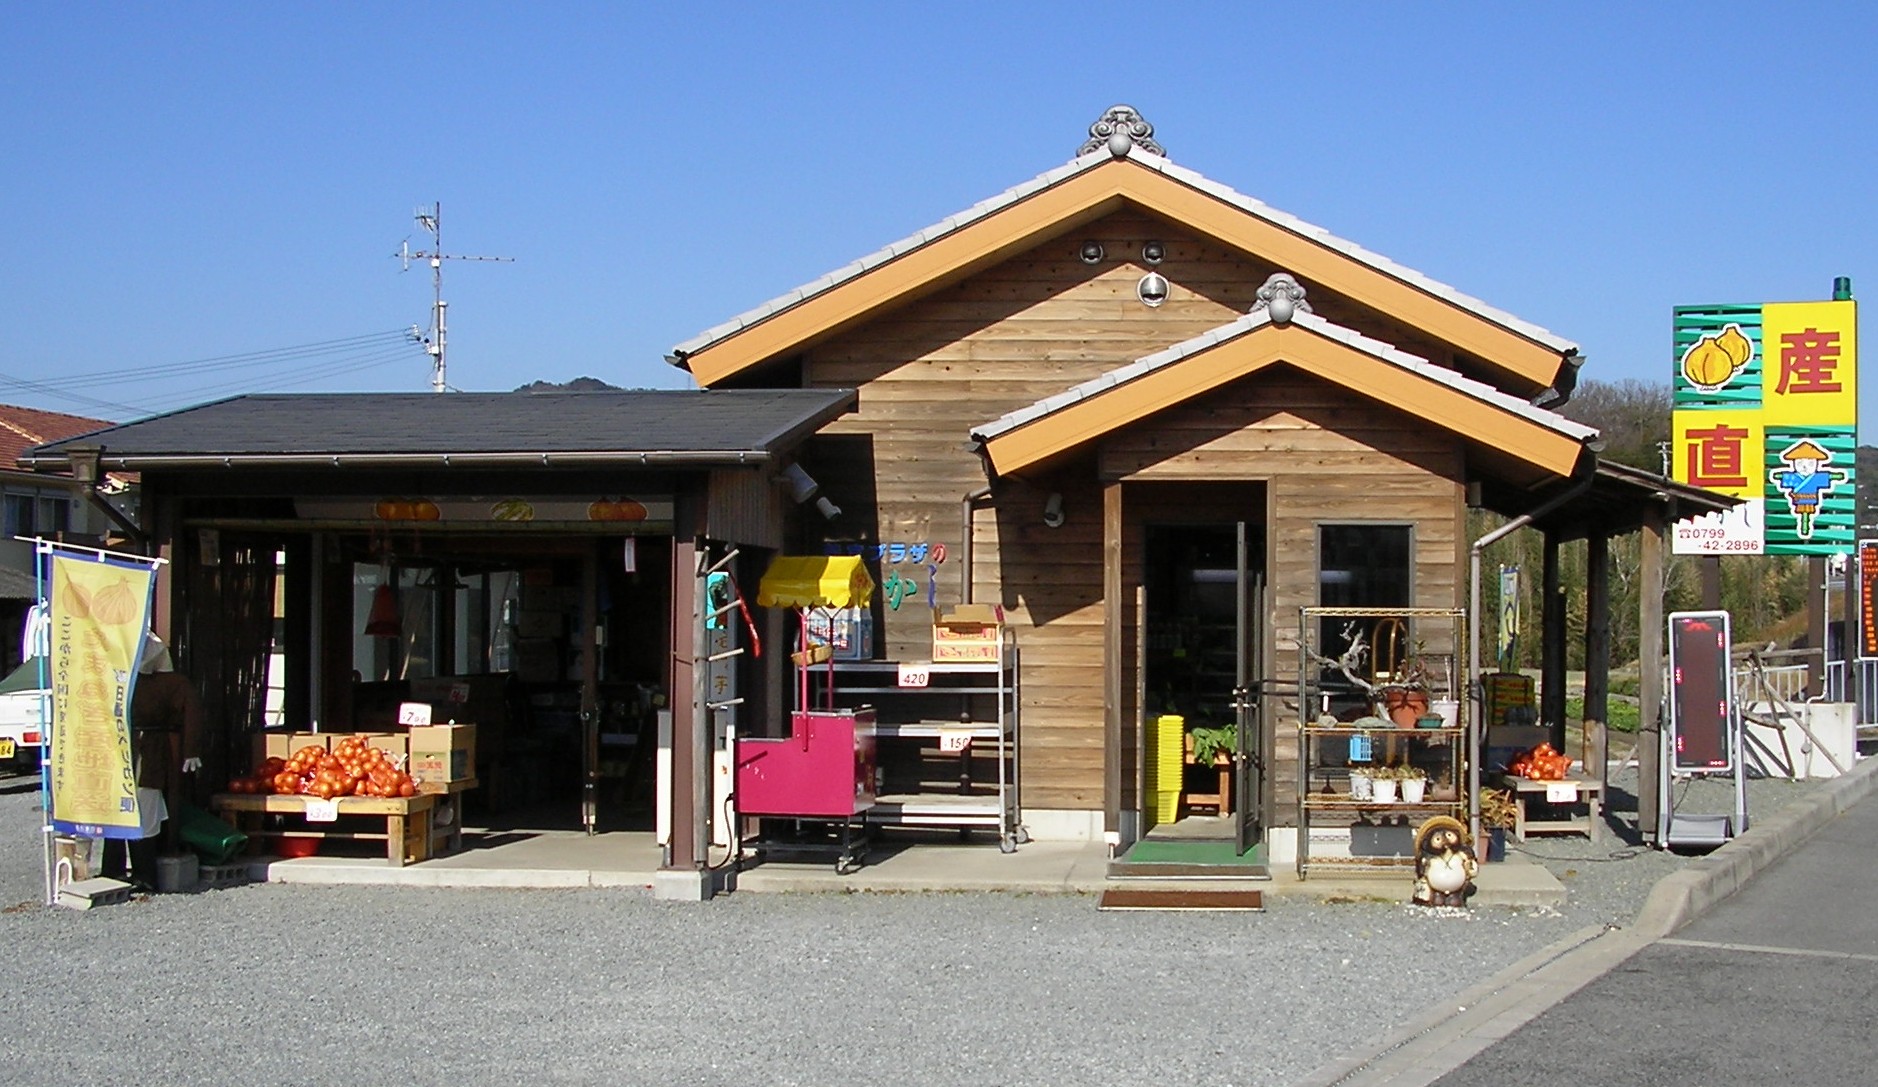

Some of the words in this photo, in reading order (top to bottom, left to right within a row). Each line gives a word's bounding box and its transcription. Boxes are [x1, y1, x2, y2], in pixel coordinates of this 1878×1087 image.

[1775, 328, 1842, 396] 産
[1686, 424, 1749, 488] 直
[1692, 528, 1725, 539] 0799
[903, 673, 926, 684] 420
